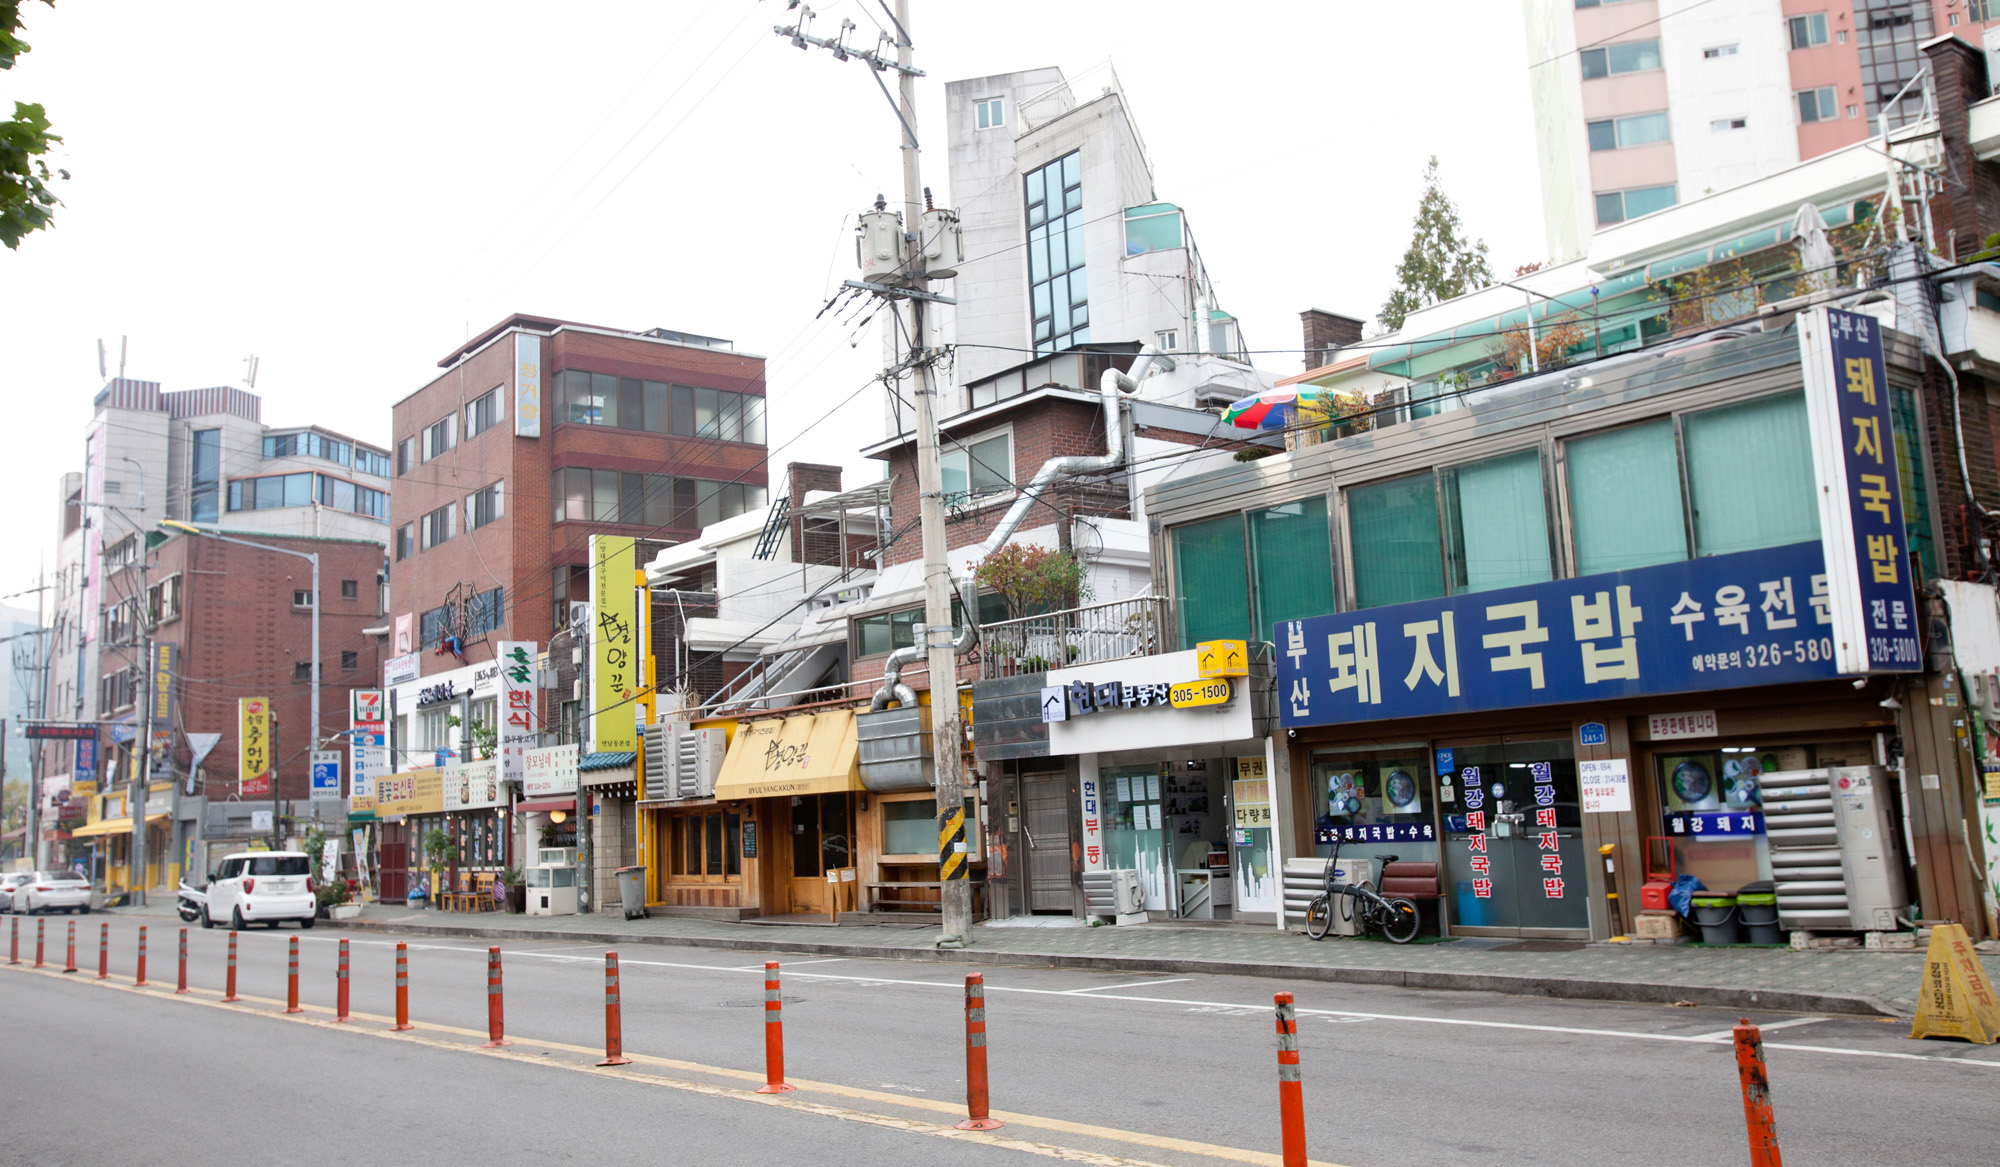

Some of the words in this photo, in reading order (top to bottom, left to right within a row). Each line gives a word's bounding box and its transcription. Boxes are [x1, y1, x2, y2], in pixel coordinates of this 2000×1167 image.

[1839, 314, 1869, 343] 부산
[521, 363, 539, 419] 정거장
[1845, 358, 1898, 584] 돼지국밥
[1670, 576, 1832, 641] 수육전문
[1871, 599, 1908, 631] 전문
[1328, 585, 1643, 705] 돼지국밥
[1871, 637, 1917, 663] 326-5800
[1286, 630, 1310, 717] 부산
[1692, 651, 1741, 672] 예약문의
[1173, 684, 1227, 702] 305-1500
[507, 690, 532, 731] 한식
[1652, 715, 1714, 735] 포장판매됩니다
[1584, 734, 1604, 742] 241-1
[1240, 761, 1268, 776] 무권
[1581, 763, 1596, 772] OPEN
[1952, 941, 1993, 1007] 주차금지
